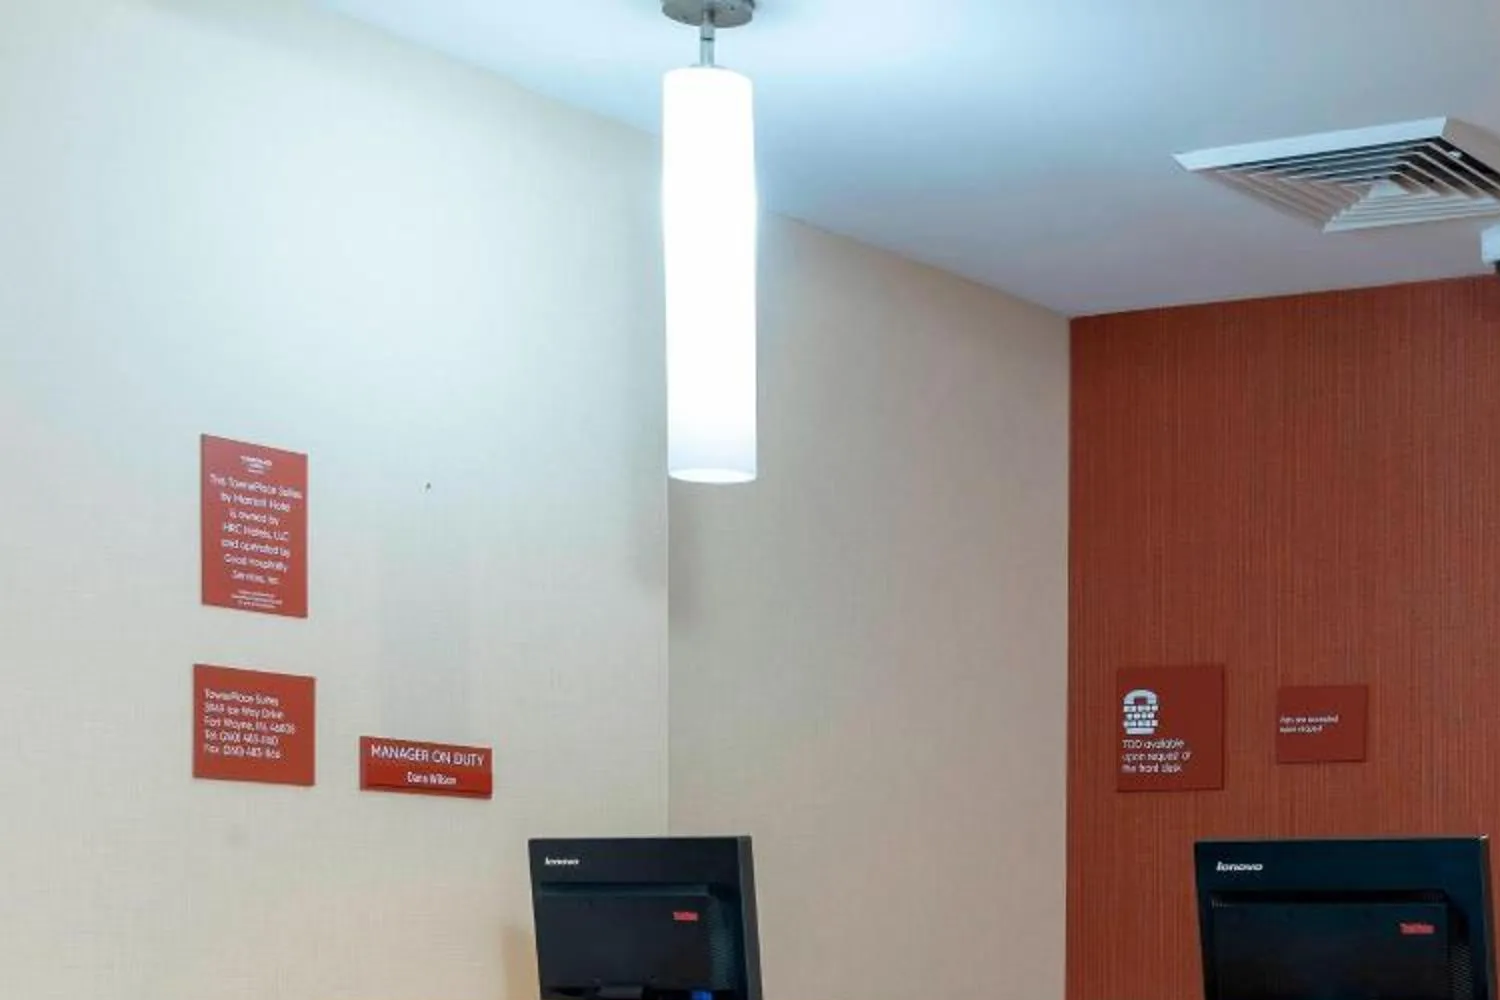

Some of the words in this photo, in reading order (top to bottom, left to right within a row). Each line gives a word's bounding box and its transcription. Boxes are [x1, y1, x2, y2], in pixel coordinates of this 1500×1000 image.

[371, 744, 429, 762] MANAGER
[431, 750, 451, 763] ON
[453, 752, 485, 766] DUTY
[1216, 861, 1264, 872] lenovo
